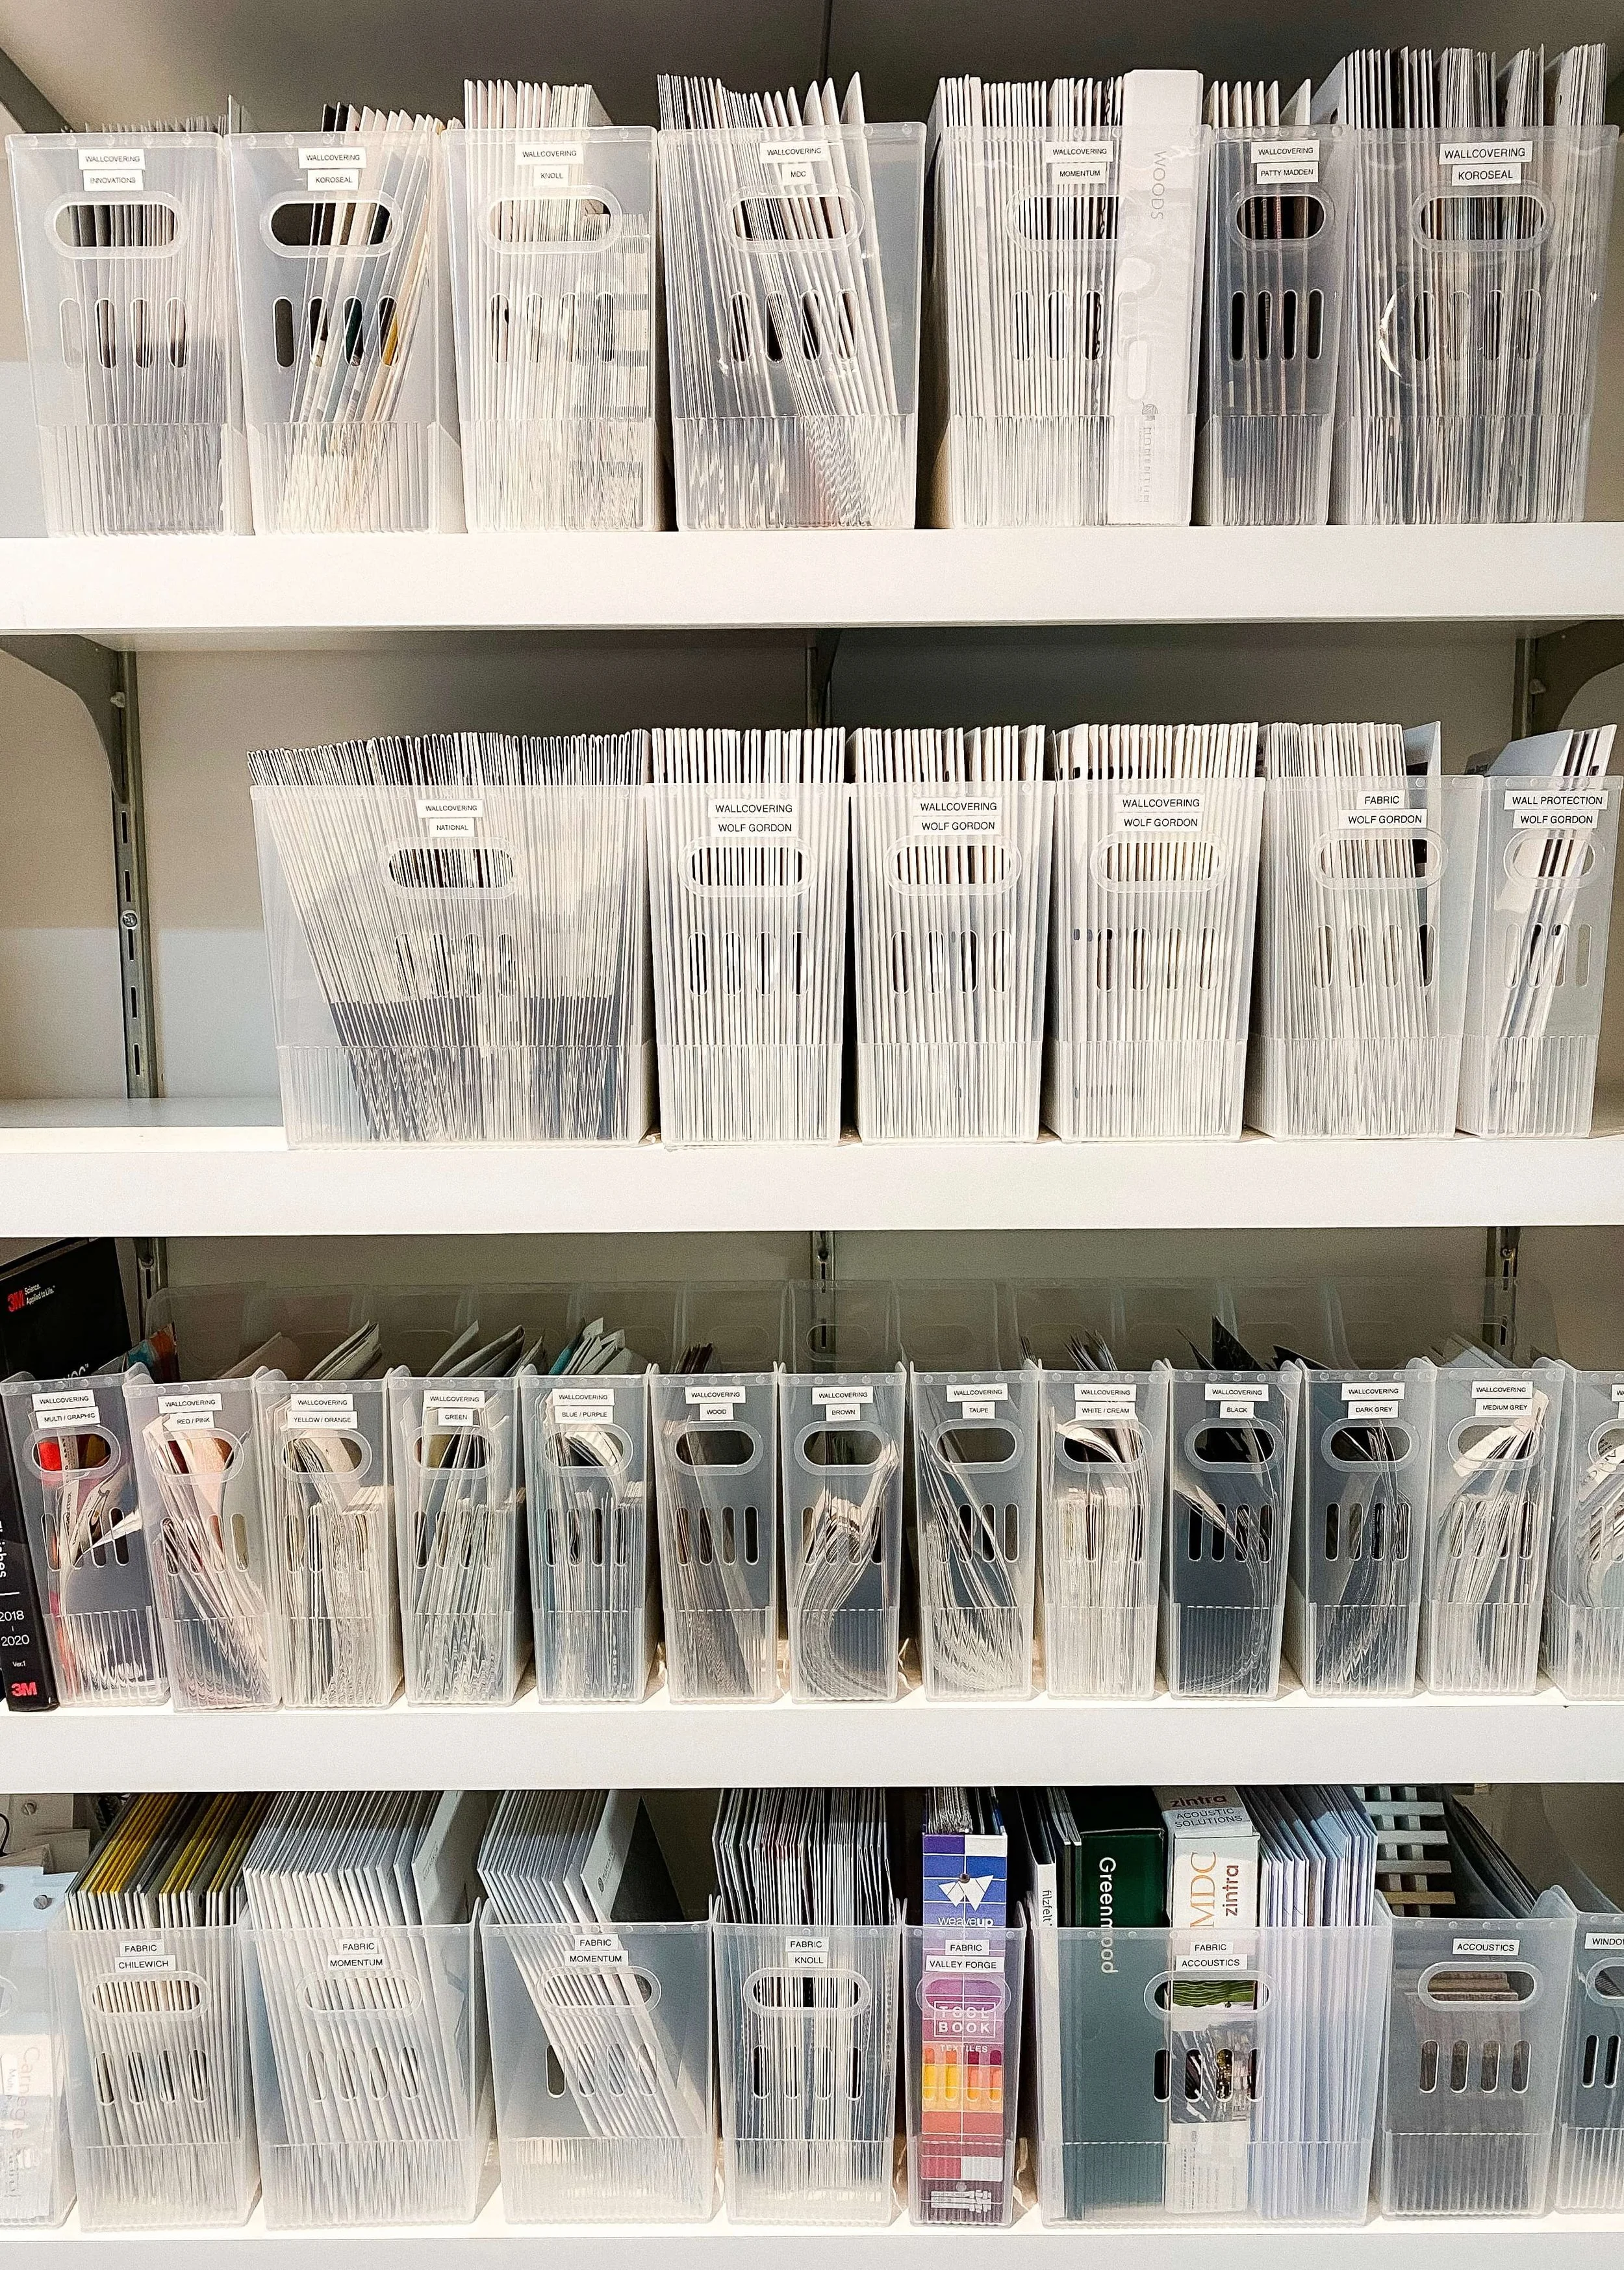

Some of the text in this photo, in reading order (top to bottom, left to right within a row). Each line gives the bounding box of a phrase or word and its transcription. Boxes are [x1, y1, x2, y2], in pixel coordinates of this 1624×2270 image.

[1258, 147, 1314, 155] WALLCOVERING
[1444, 147, 1526, 159] WALLCOVERING
[1458, 170, 1513, 181] KOROSEAL
[1150, 150, 1166, 219] WOODS
[1122, 799, 1200, 808] WALLCOVERING
[1364, 796, 1400, 804] FABRIC
[1512, 796, 1603, 805] WALL PROTECTION
[715, 804, 793, 813] WALLCOVERING
[920, 802, 997, 811] WALLCOVERING
[1123, 818, 1198, 827] WOLF GORDON
[1348, 815, 1422, 824] WOLF GORDON
[1520, 815, 1593, 824] WOLF GORDON
[718, 823, 792, 832] WOLF GORDON
[921, 821, 995, 830] WOLF GORDON
[7, 1290, 25, 1312] 3M
[39, 1395, 89, 1405] WALLCOVERING
[44, 1414, 62, 1423] MULTI
[67, 1412, 96, 1421] GRAPHIC
[0, 1610, 25, 1622] 2018
[1, 1634, 30, 1646] 2020
[11, 1681, 38, 1697] 3M
[1169, 1795, 1228, 1808] zintra
[1176, 1807, 1235, 1819] ACOUSTIC
[1174, 1815, 1243, 1828] SOLUTIONS
[1189, 1852, 1217, 1928] MDC
[1222, 1865, 1239, 1917] zintra
[937, 1917, 994, 1928] weaveup
[1592, 1937, 1624, 1946] WINDO
[1194, 1943, 1227, 1952] FABRIC
[1457, 1943, 1514, 1952] ACCOUSTICS
[329, 1958, 383, 1967] MOMENTUM
[569, 1954, 622, 1963] MOMENTUM
[794, 1956, 824, 1965] KNOLL
[1182, 1959, 1240, 1967] ACCOUSTICS
[118, 1959, 169, 1969] CHILEWICH
[929, 1960, 996, 1969] VALLEY FORGE
[937, 2006, 990, 2019] TOOL
[938, 2022, 991, 2034] BOOK
